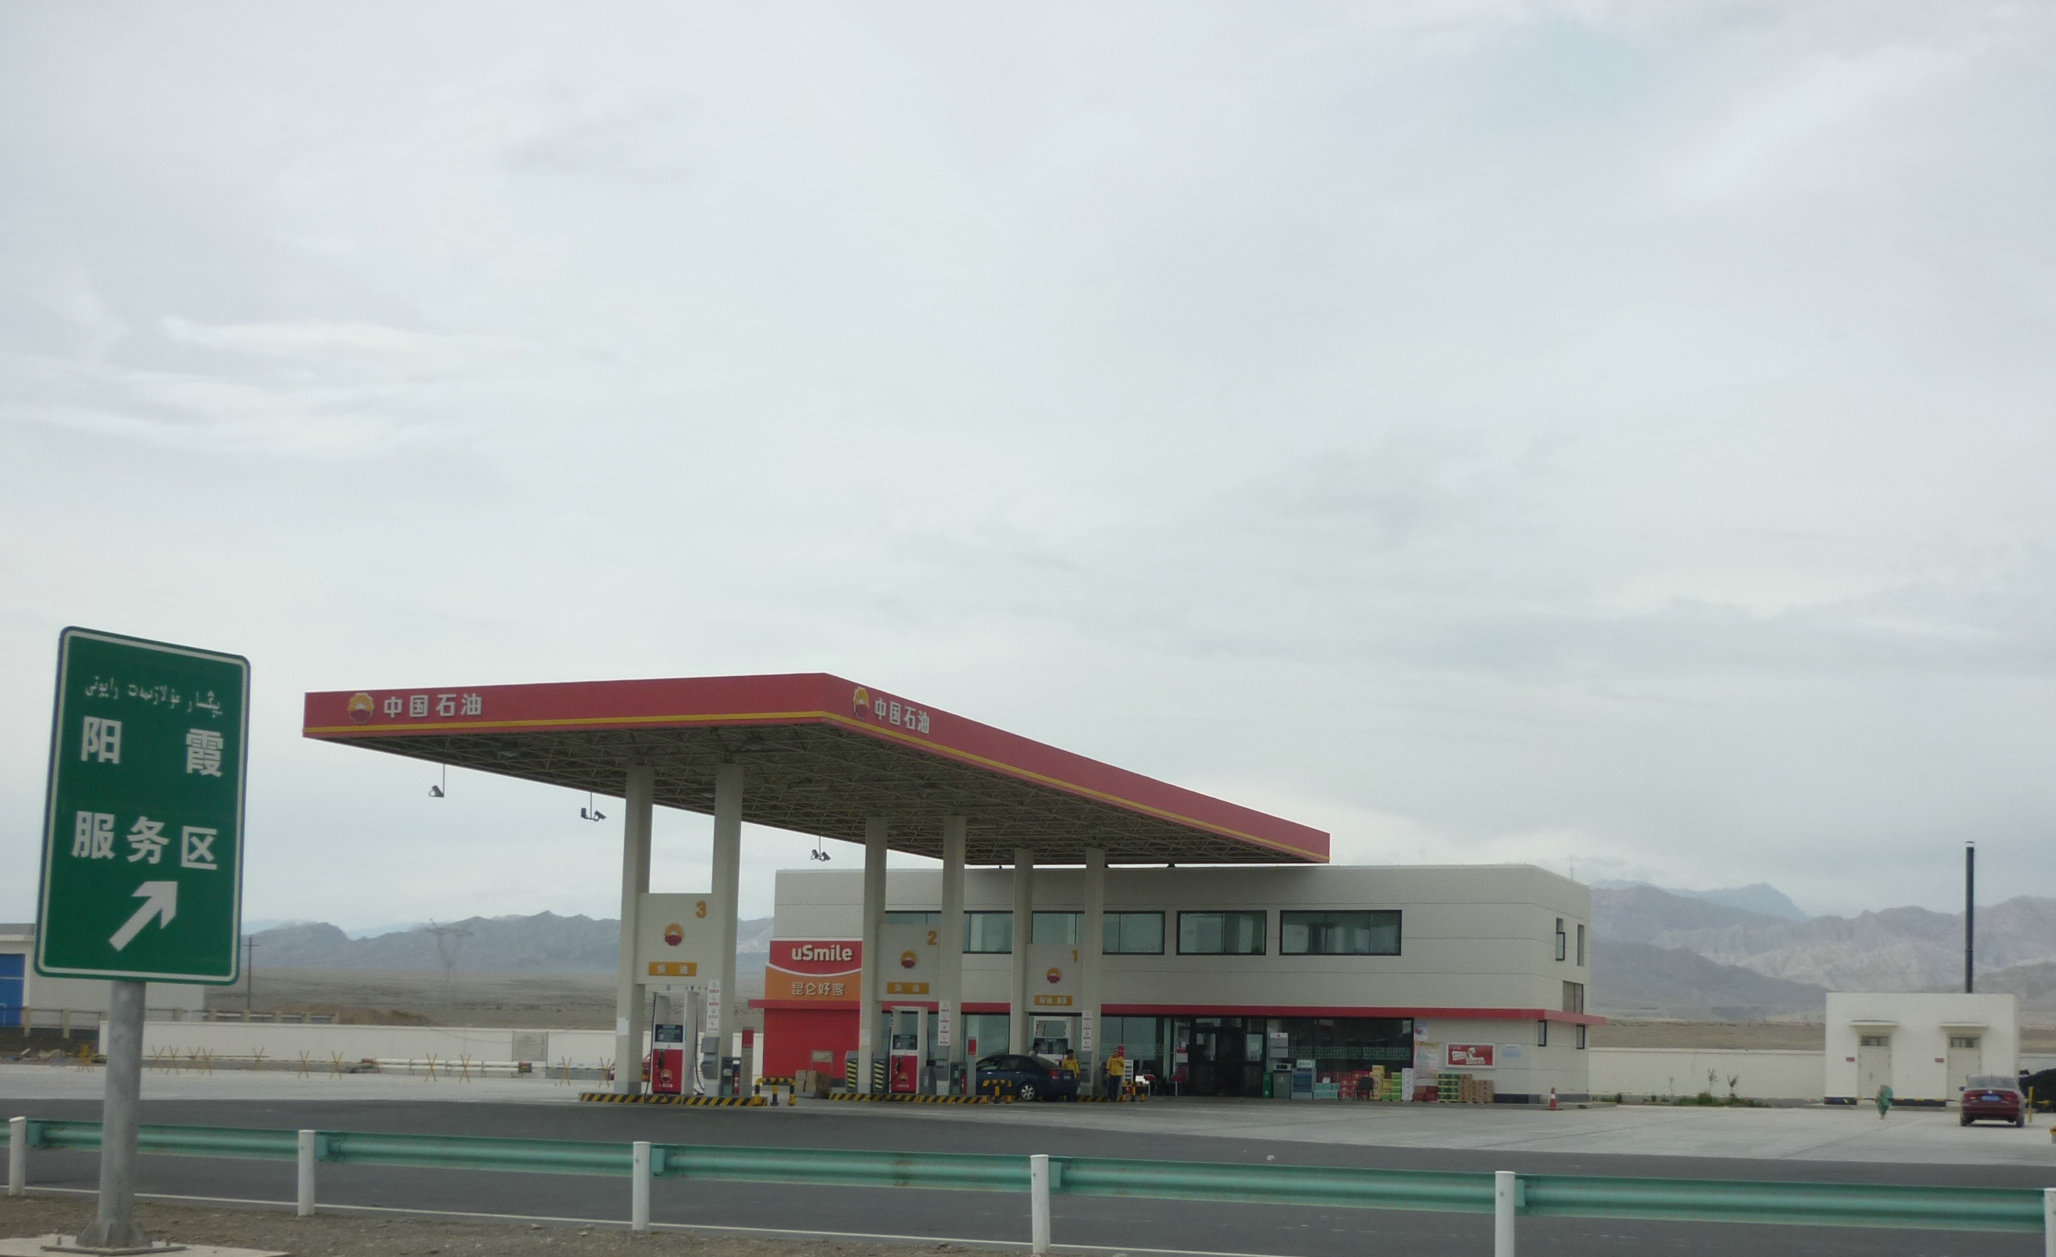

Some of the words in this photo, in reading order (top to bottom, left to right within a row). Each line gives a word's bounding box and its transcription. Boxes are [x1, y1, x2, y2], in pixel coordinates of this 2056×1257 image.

[384, 693, 482, 717] 中国石油
[874, 698, 930, 734] 中国石油
[72, 811, 217, 870] 服务区
[695, 900, 707, 918] 3
[927, 931, 938, 946] 2
[791, 944, 854, 961] uSmile
[1072, 949, 1079, 963] 1
[792, 982, 845, 997] 昆仑好客
